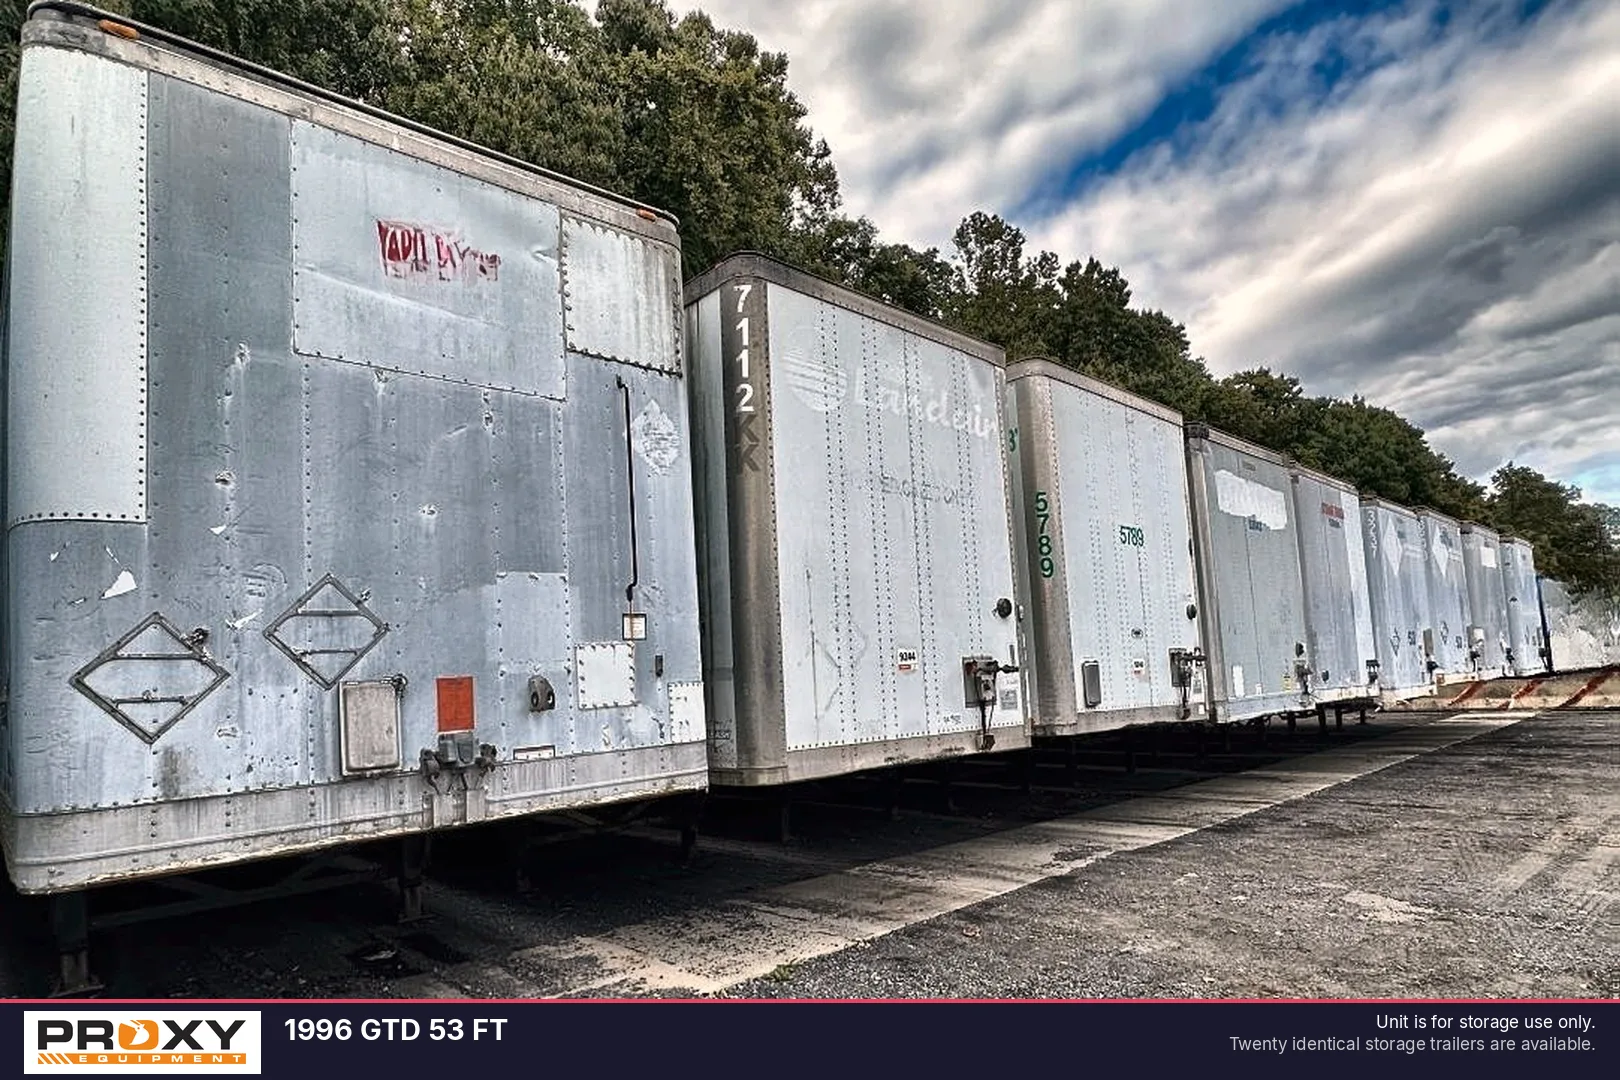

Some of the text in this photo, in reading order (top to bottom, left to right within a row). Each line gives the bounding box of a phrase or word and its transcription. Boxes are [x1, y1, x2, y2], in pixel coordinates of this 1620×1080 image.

[733, 284, 755, 412] 7112
[1035, 492, 1054, 578] 5789
[1118, 525, 1145, 547] 5789
